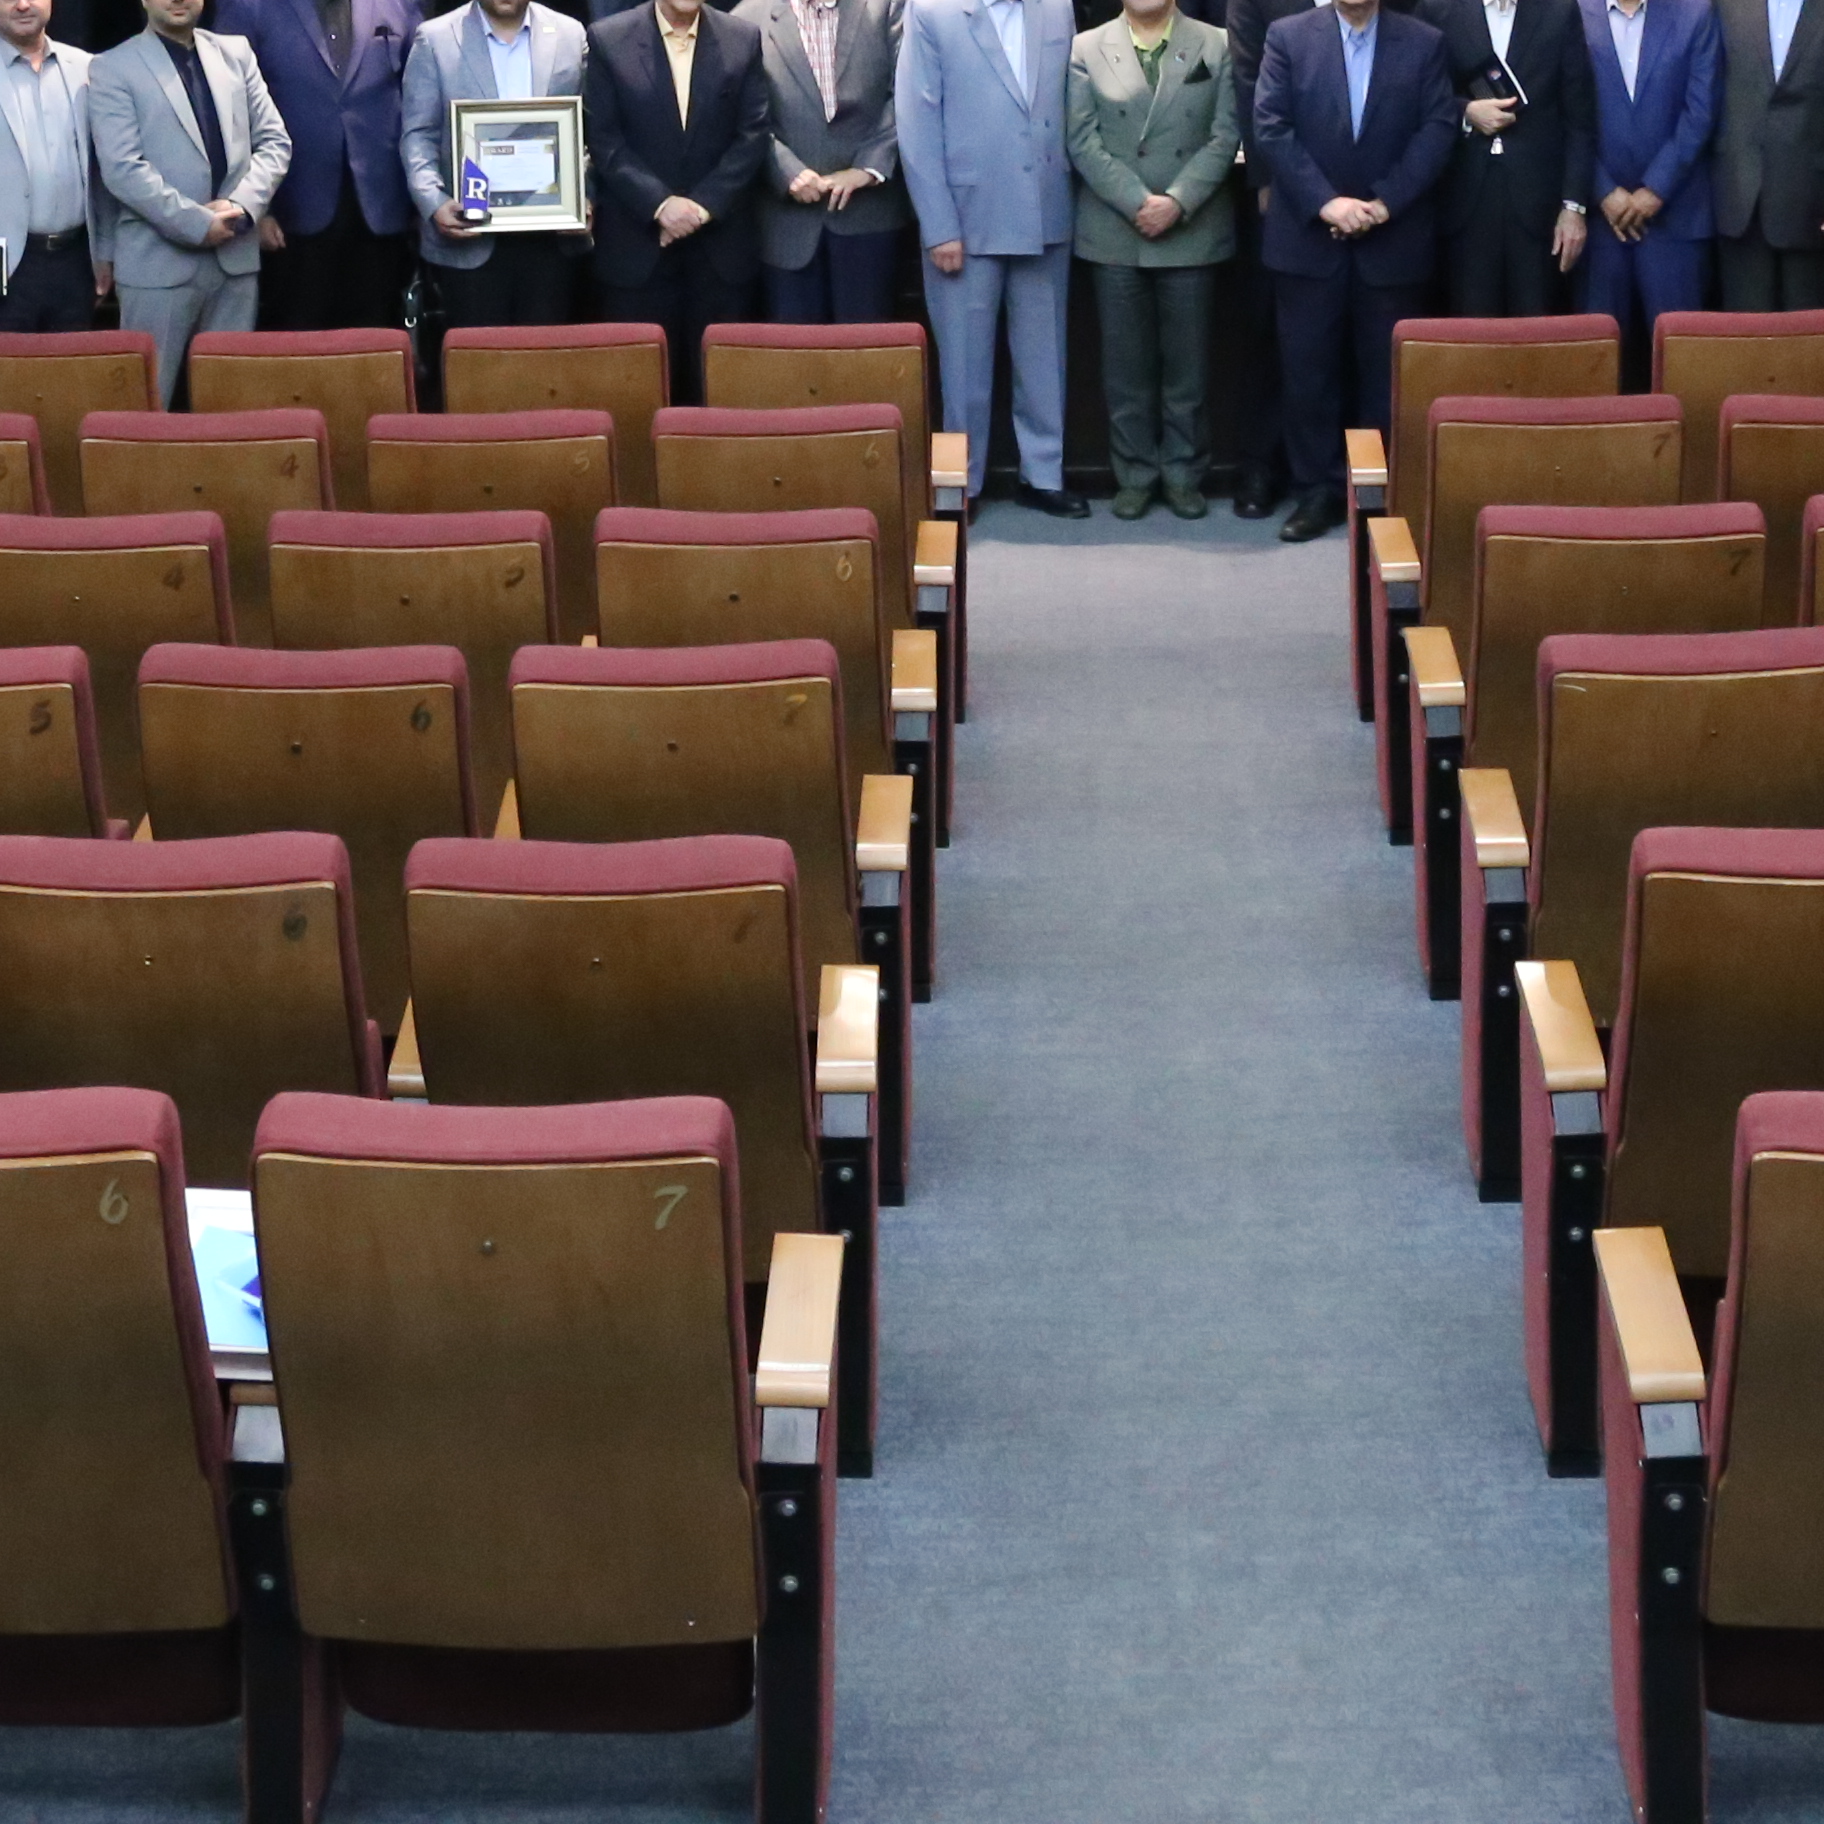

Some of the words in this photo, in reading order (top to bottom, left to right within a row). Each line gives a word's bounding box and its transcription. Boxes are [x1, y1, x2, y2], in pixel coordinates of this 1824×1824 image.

[465, 177, 488, 201] R
[1652, 431, 1673, 459] 7
[572, 449, 591, 475] 5
[836, 550, 853, 583] 6
[1728, 546, 1752, 576] 7
[28, 698, 53, 737] 5
[409, 698, 433, 733] 6
[100, 1177, 129, 1226] 6
[652, 1184, 690, 1231] 7
